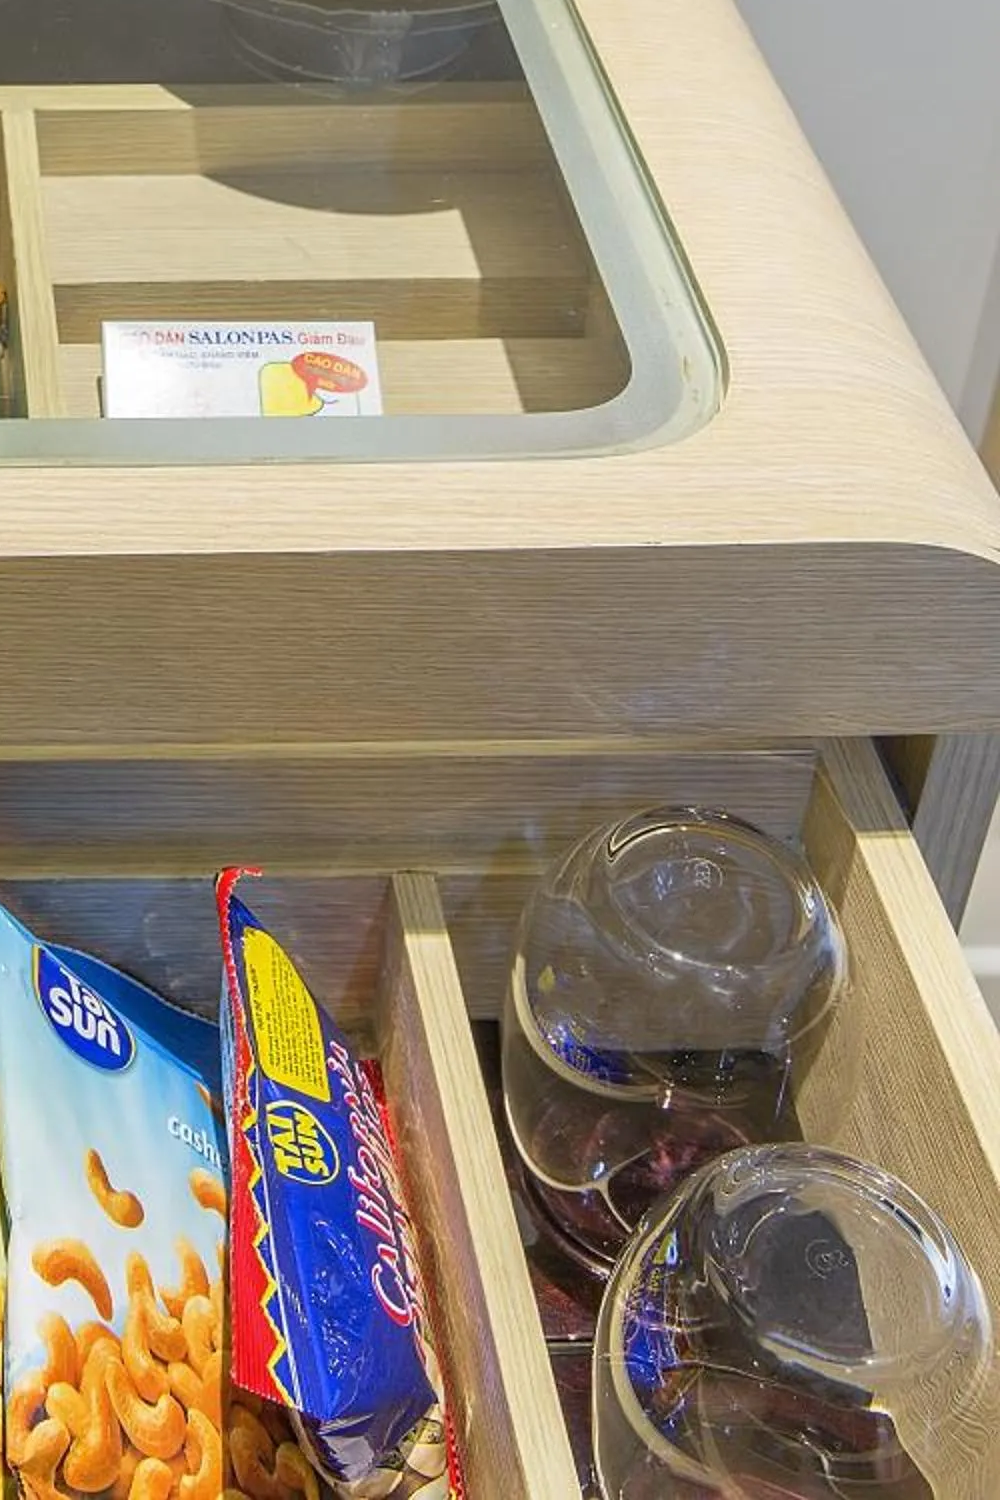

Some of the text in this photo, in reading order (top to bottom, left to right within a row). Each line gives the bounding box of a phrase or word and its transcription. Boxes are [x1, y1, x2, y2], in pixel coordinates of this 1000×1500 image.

[188, 331, 293, 346] SALONPAS
[267, 1113, 303, 1175] TAI
[293, 1110, 330, 1177] SUN
